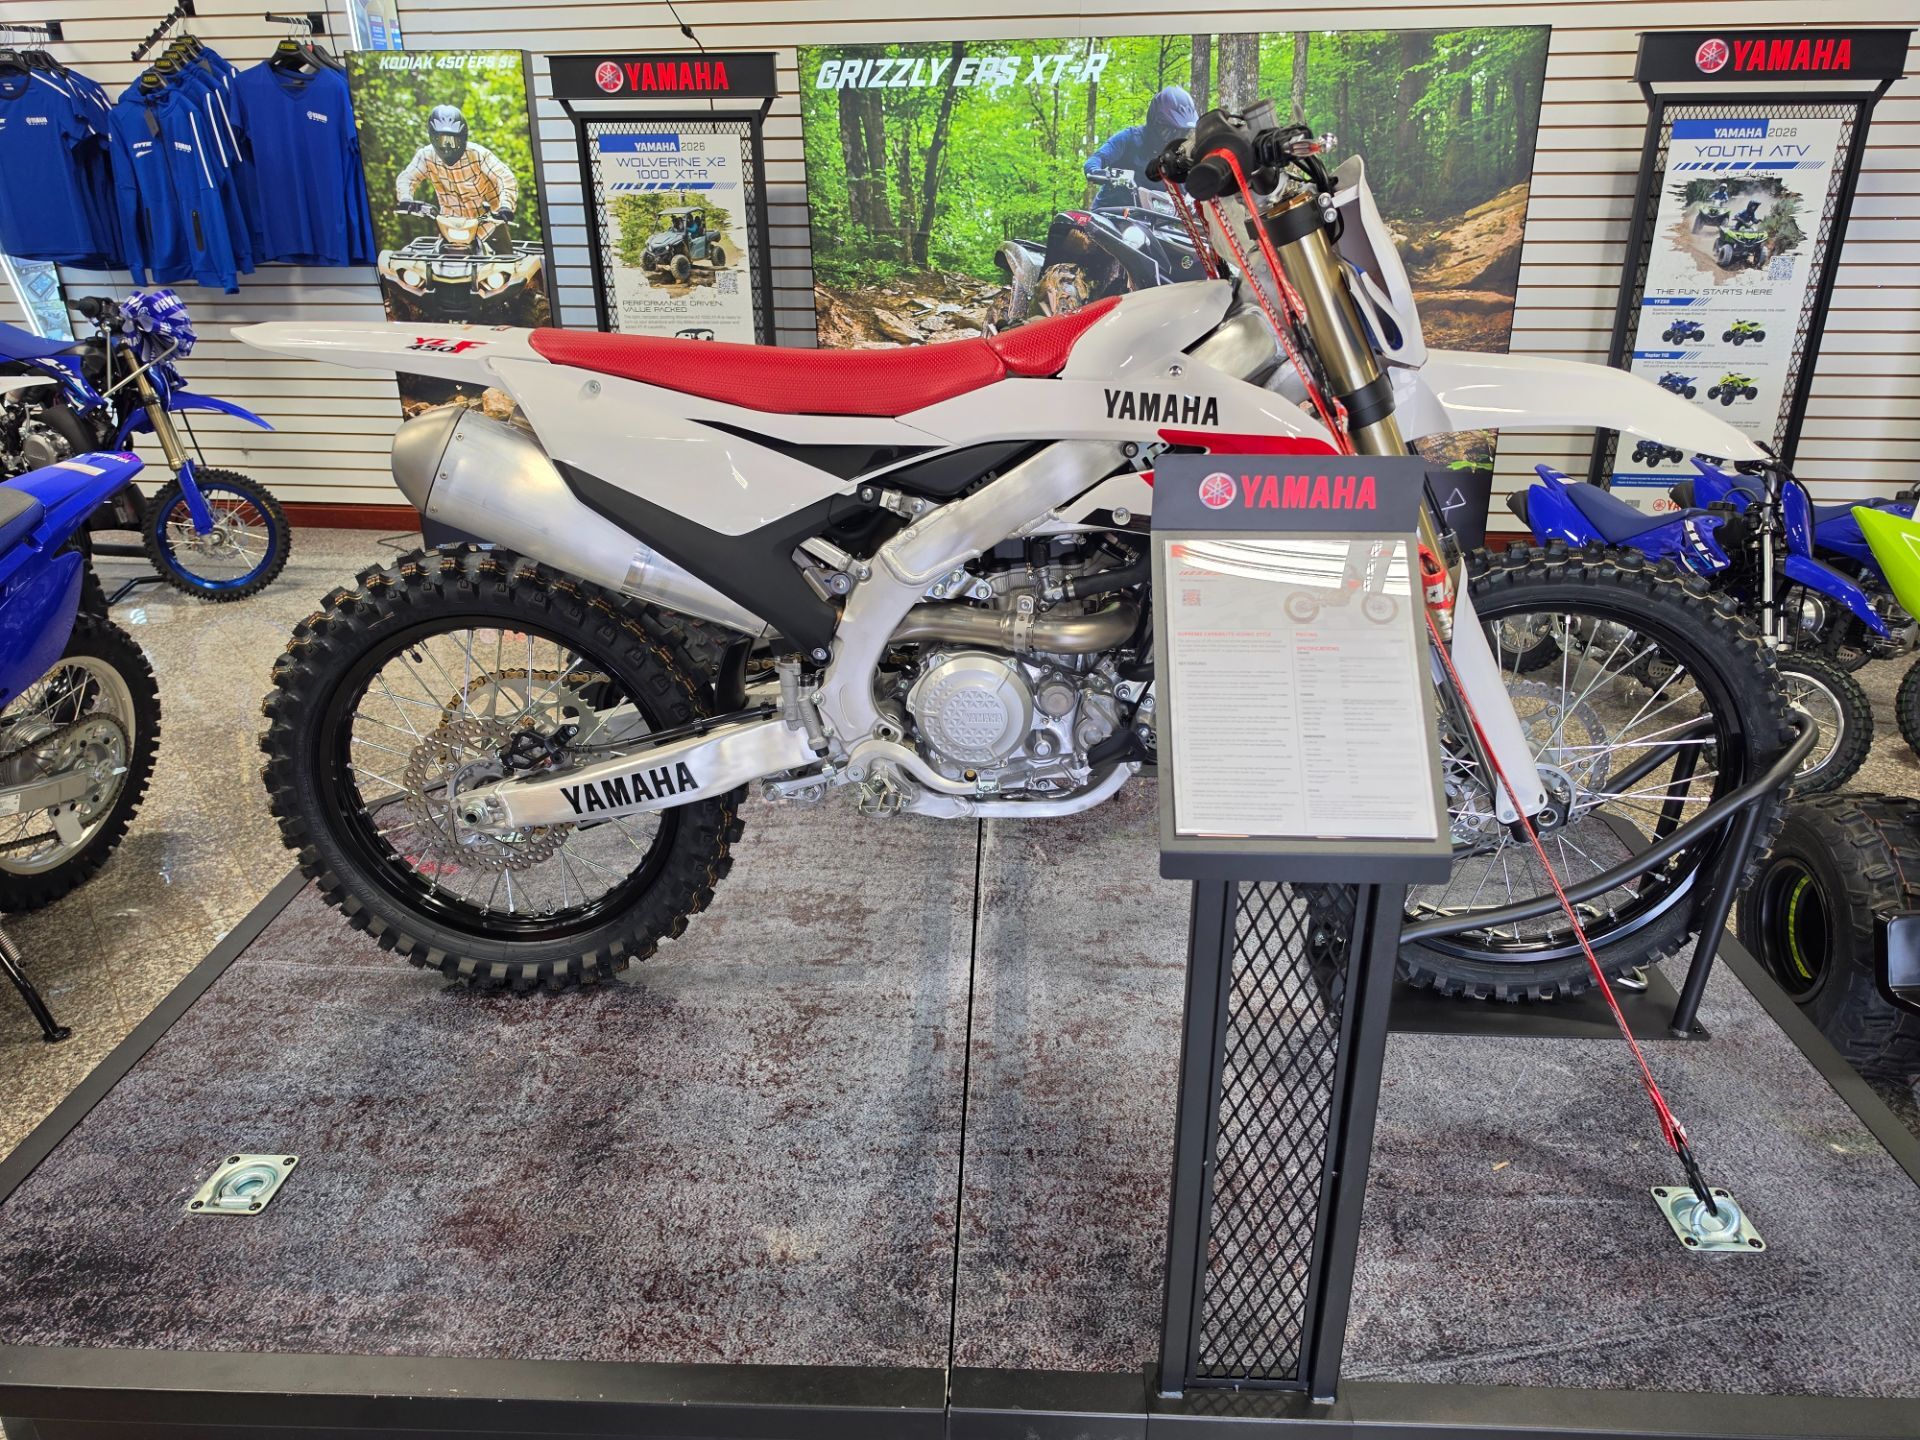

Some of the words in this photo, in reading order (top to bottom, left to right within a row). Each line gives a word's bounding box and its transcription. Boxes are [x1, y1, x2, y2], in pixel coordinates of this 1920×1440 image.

[1733, 39, 1852, 71] YAMAHA
[379, 56, 434, 70] KODIAK
[436, 56, 464, 69] 450
[468, 56, 494, 69] EPS
[624, 61, 730, 91] YAMAHA
[815, 57, 953, 89] GRIZZLY
[952, 56, 1021, 87] EPS
[1023, 53, 1108, 85] XT-R
[1714, 128, 1763, 138] YAMAHA
[1767, 127, 1797, 137] 2026
[634, 142, 677, 152] YAMAHA
[681, 142, 705, 151] 2026
[1694, 145, 1763, 158] YOUTH
[1769, 144, 1811, 157] ATV
[616, 157, 701, 167] WOLVERINE
[706, 157, 726, 167] X2
[636, 170, 670, 180] 1000
[675, 169, 708, 179] XT-R
[1702, 288, 1743, 296] STARTS
[1104, 388, 1219, 426] YAMAHA
[1240, 475, 1376, 509] YAMAHA
[560, 761, 699, 815] YAMAHA
